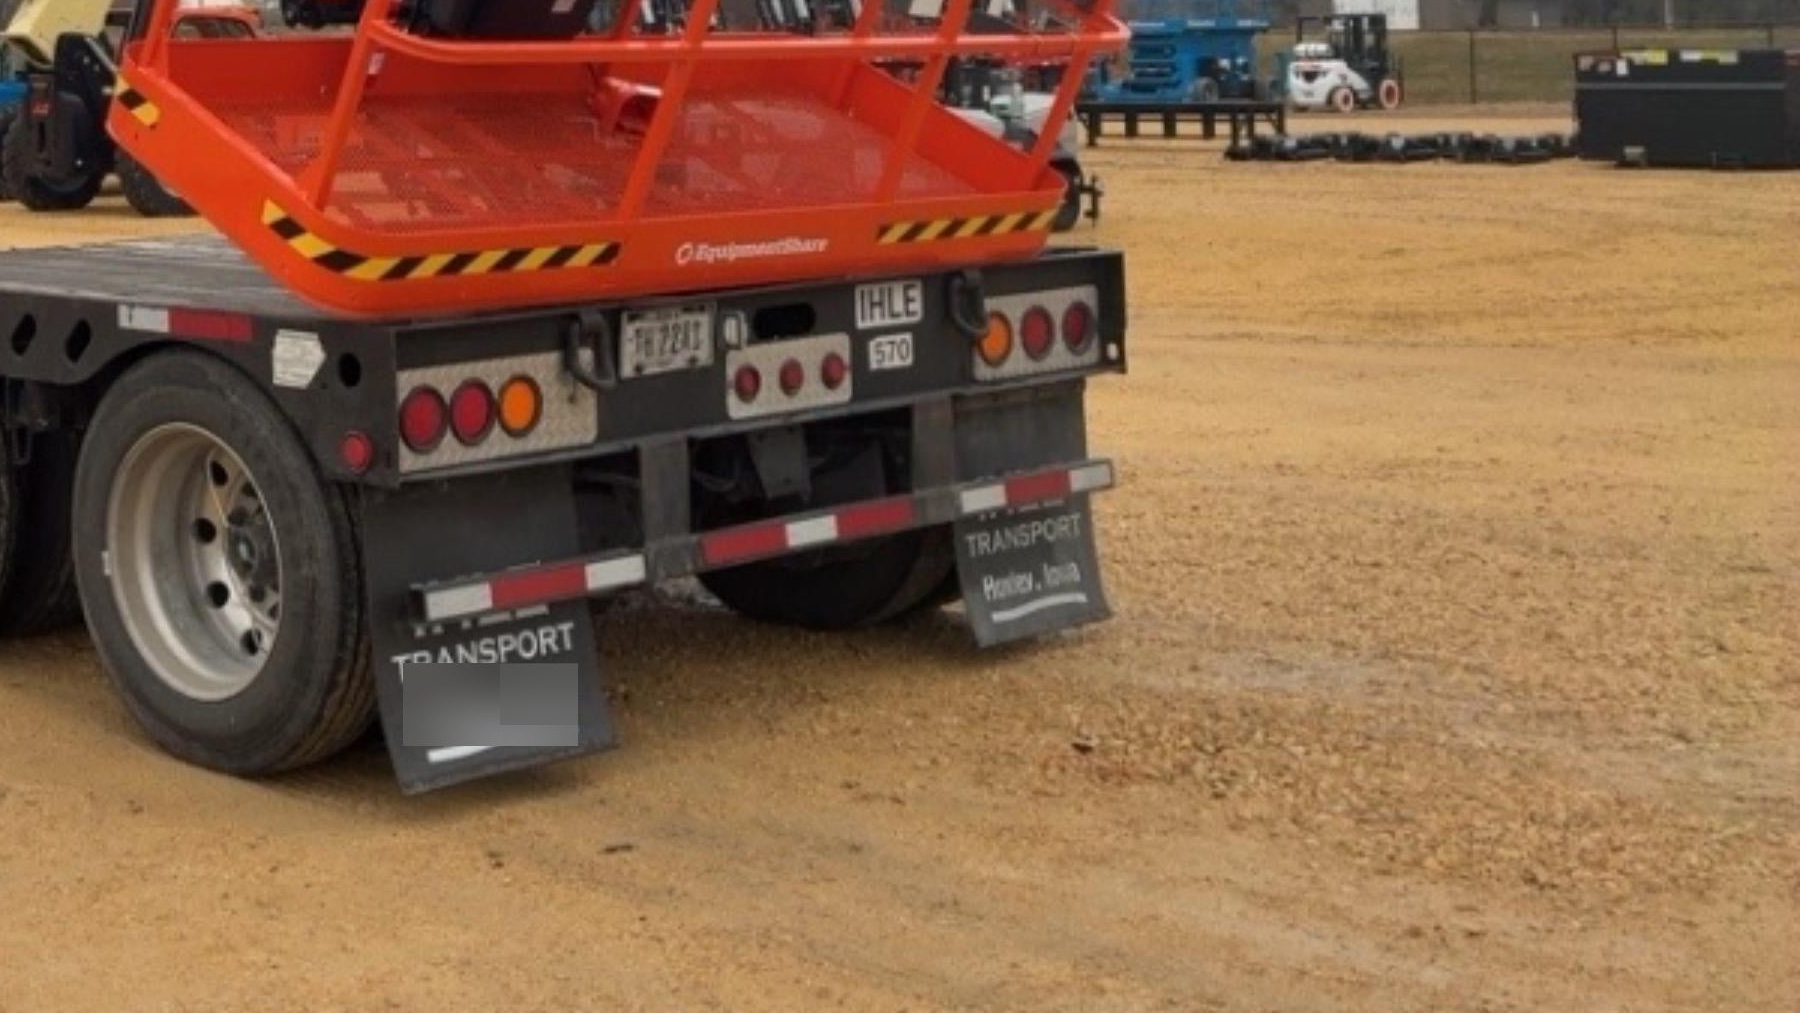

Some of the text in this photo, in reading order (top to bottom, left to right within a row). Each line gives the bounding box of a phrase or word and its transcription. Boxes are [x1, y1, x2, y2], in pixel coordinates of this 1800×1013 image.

[695, 238, 829, 264] EquipmentShare
[859, 284, 919, 324] IHLE
[874, 339, 910, 365] 570
[966, 511, 1081, 559] TRANSPORT
